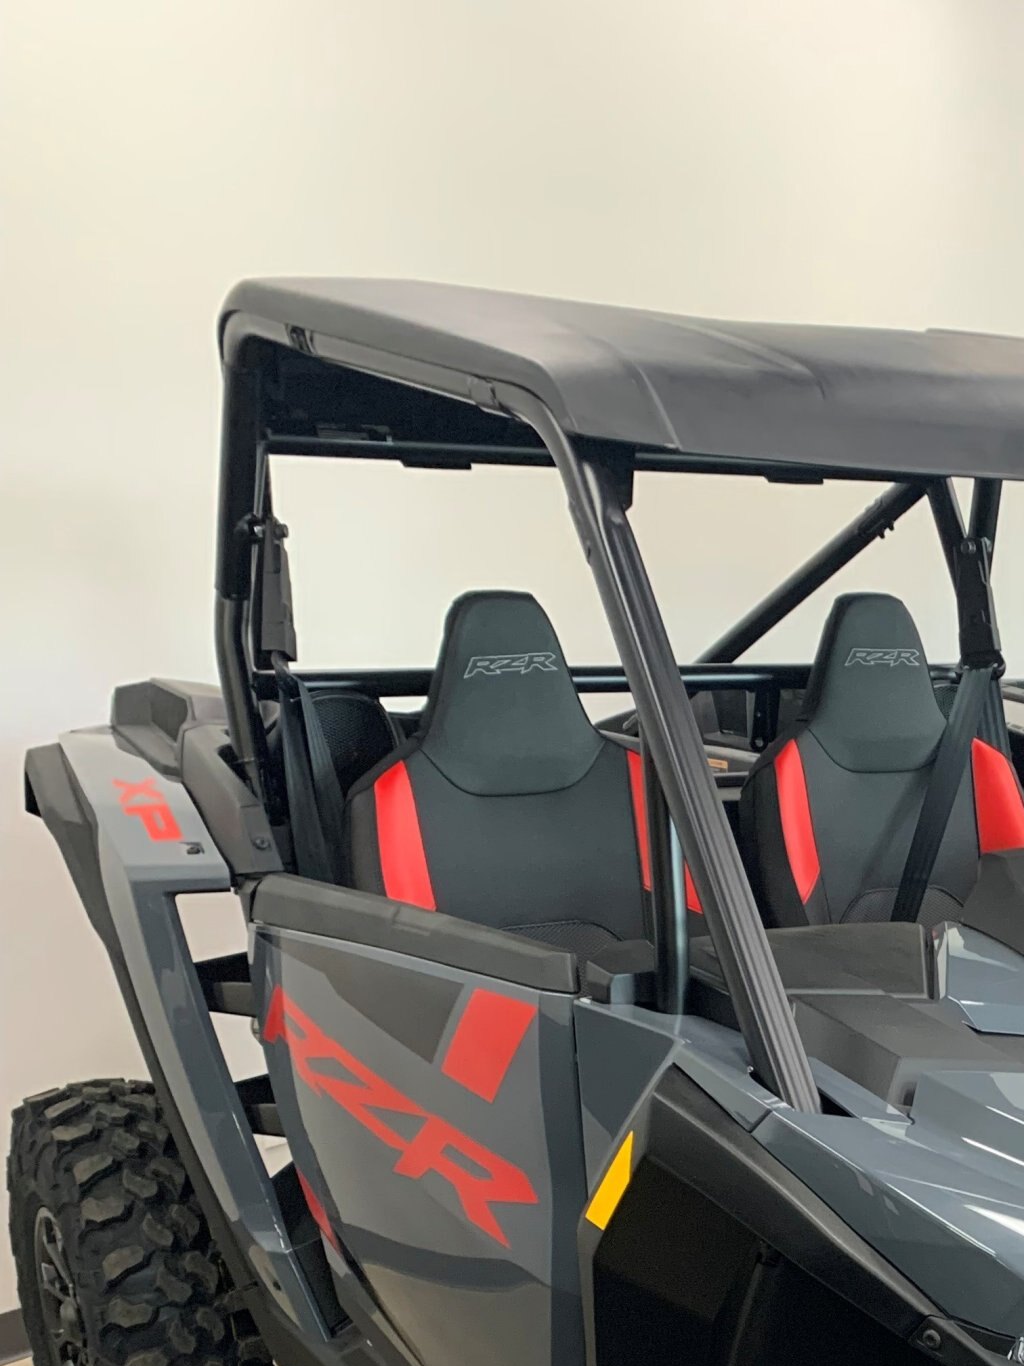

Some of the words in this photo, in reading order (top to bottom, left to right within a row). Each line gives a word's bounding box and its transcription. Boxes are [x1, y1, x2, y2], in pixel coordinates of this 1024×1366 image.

[463, 651, 558, 679] RZR
[844, 647, 920, 667] RZR
[112, 777, 183, 842] XP
[263, 983, 540, 1250] RZR
